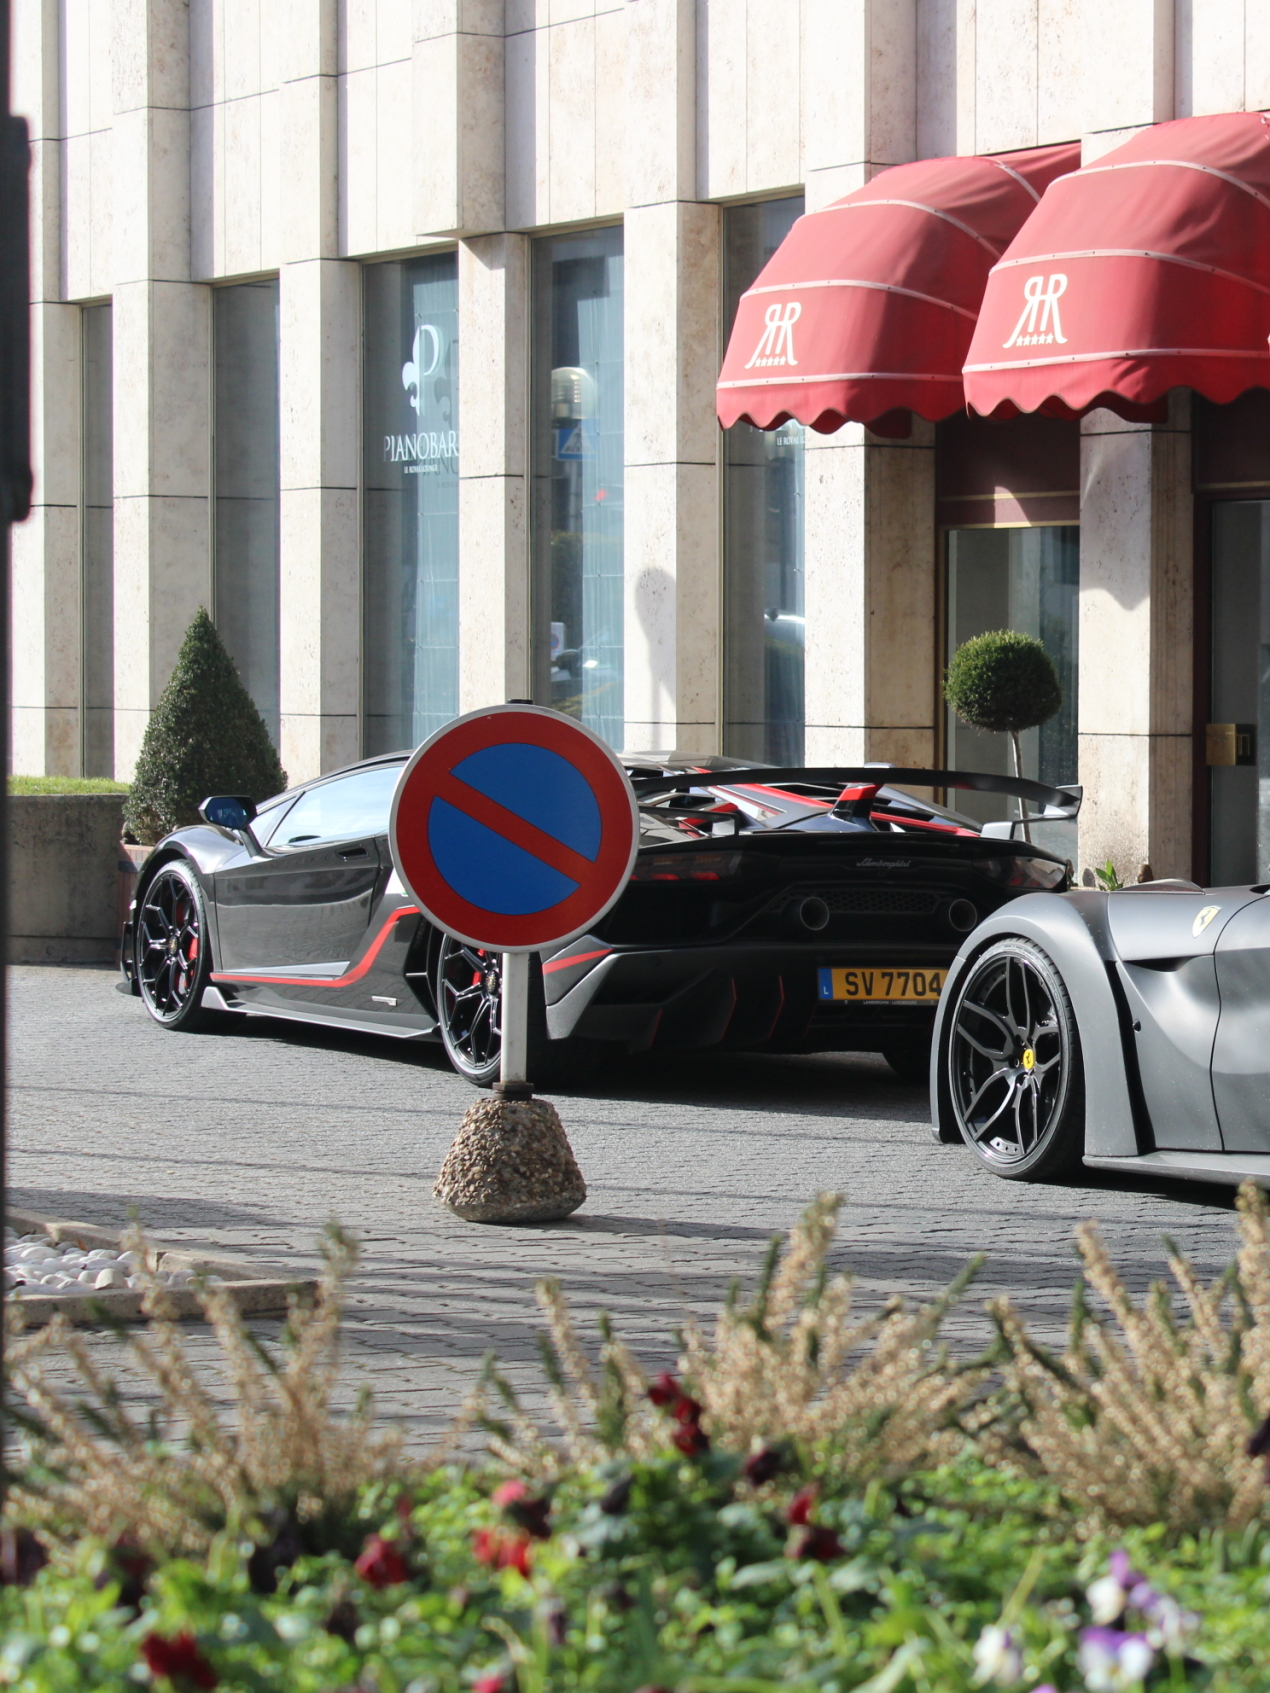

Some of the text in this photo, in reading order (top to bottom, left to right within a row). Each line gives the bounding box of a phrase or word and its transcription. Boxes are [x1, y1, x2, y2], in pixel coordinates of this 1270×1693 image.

[383, 430, 459, 462] PIANOBAR
[856, 857, 912, 869] Lamborghini
[823, 986, 829, 995] L
[845, 971, 943, 997] SV 7704
